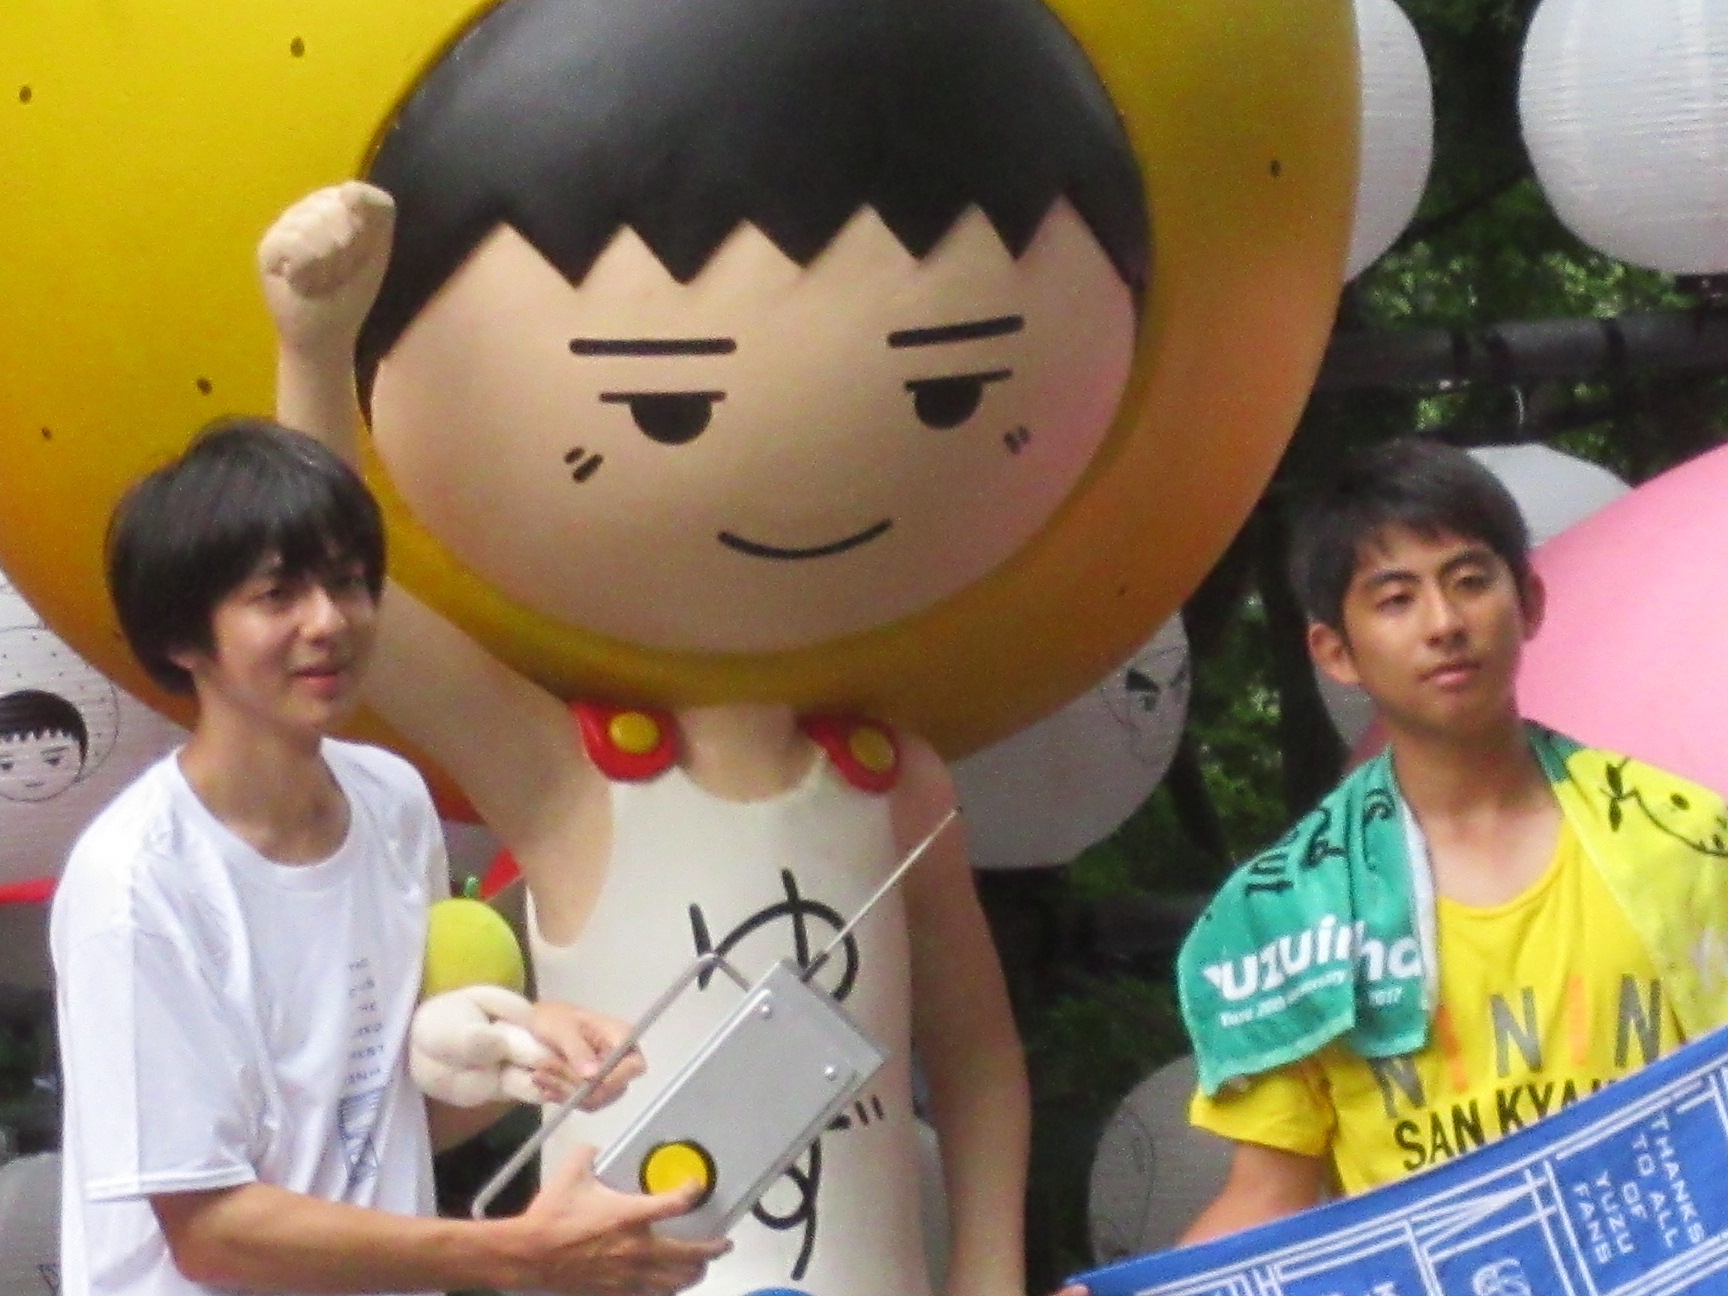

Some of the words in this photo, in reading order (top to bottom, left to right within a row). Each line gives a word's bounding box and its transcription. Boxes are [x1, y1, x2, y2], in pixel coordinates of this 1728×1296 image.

[1394, 1098, 1485, 1172] SAN
[1594, 1172, 1634, 1254] YUZU
[1622, 1182, 1647, 1218] OF
[1633, 1134, 1656, 1177] TO
[1648, 1192, 1679, 1247] ALL
[1649, 1115, 1706, 1245] THANKS
[1573, 1183, 1612, 1264] FANS
